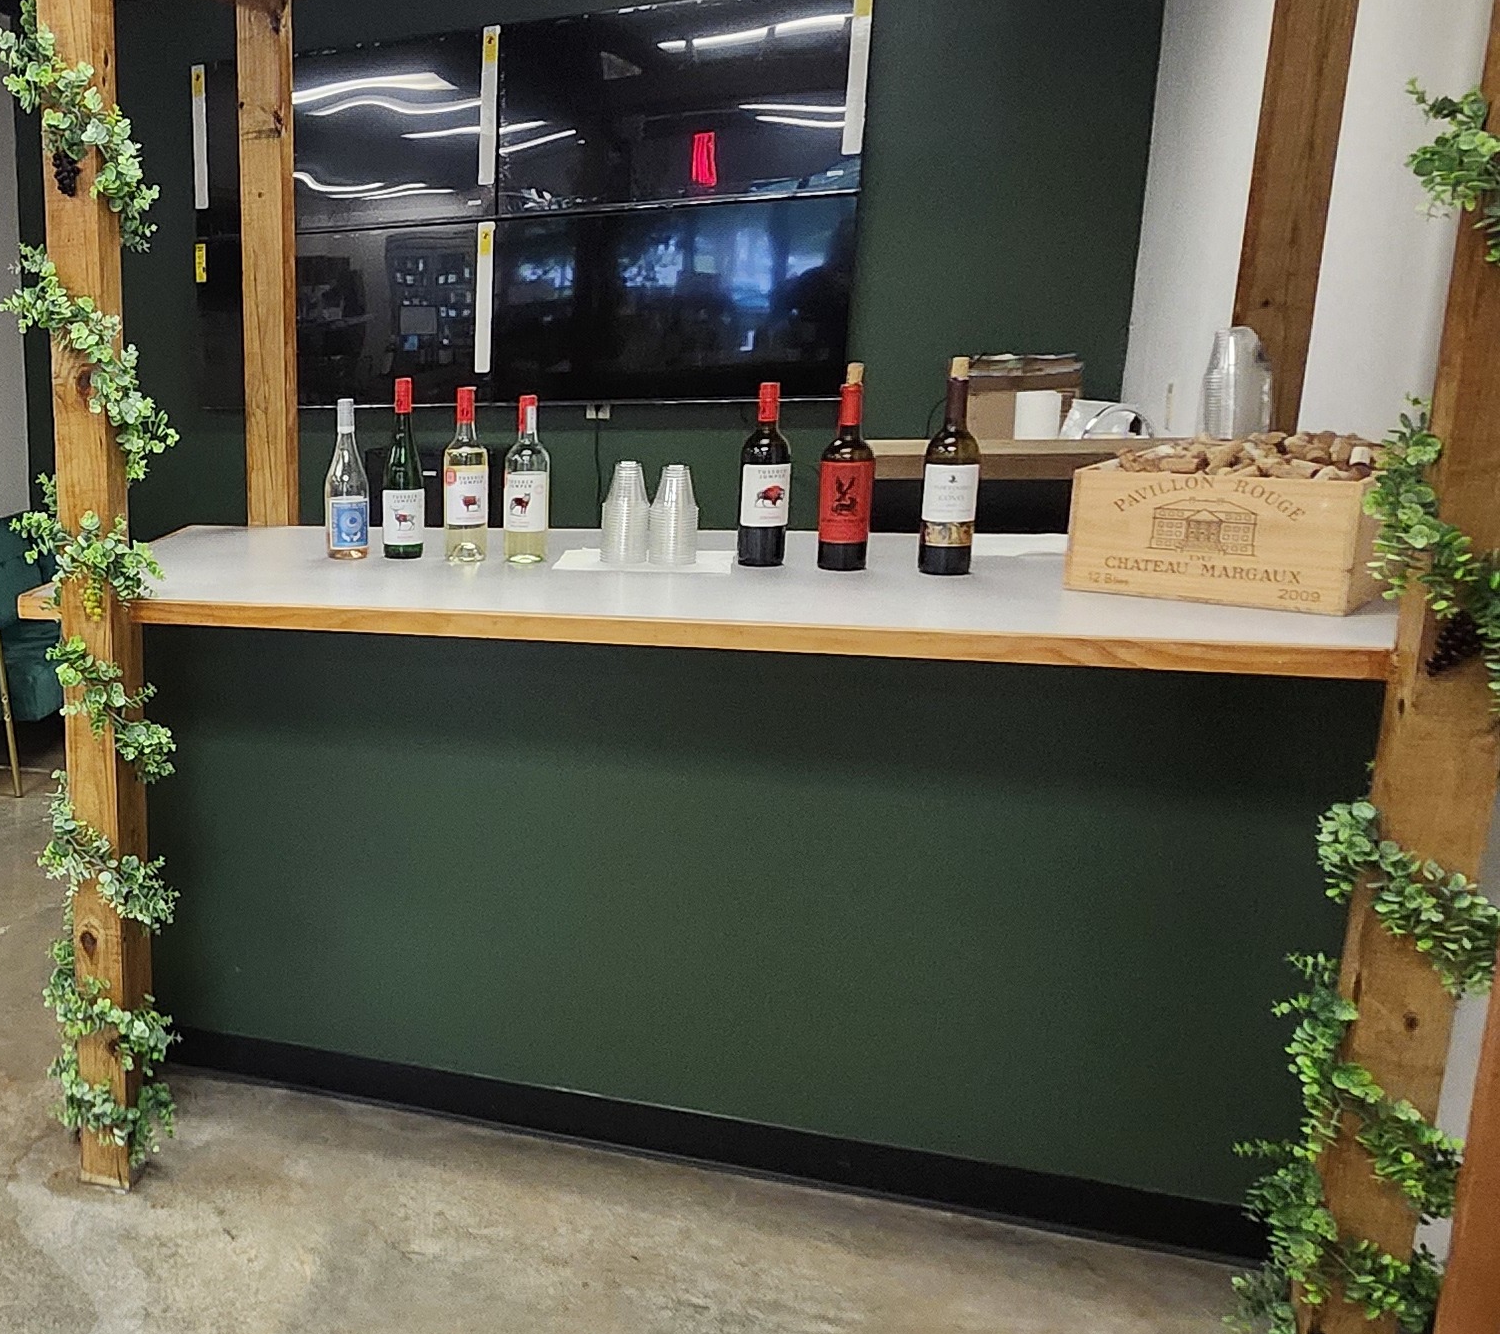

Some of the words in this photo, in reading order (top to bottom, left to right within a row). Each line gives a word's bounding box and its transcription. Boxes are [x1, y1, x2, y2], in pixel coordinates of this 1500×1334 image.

[1113, 475, 1214, 512] PAVILLON
[1232, 479, 1306, 522] ROUGE
[1104, 556, 1188, 575] CHATEAU
[1200, 563, 1301, 584] MARGAUX
[1277, 588, 1322, 603] 2009
